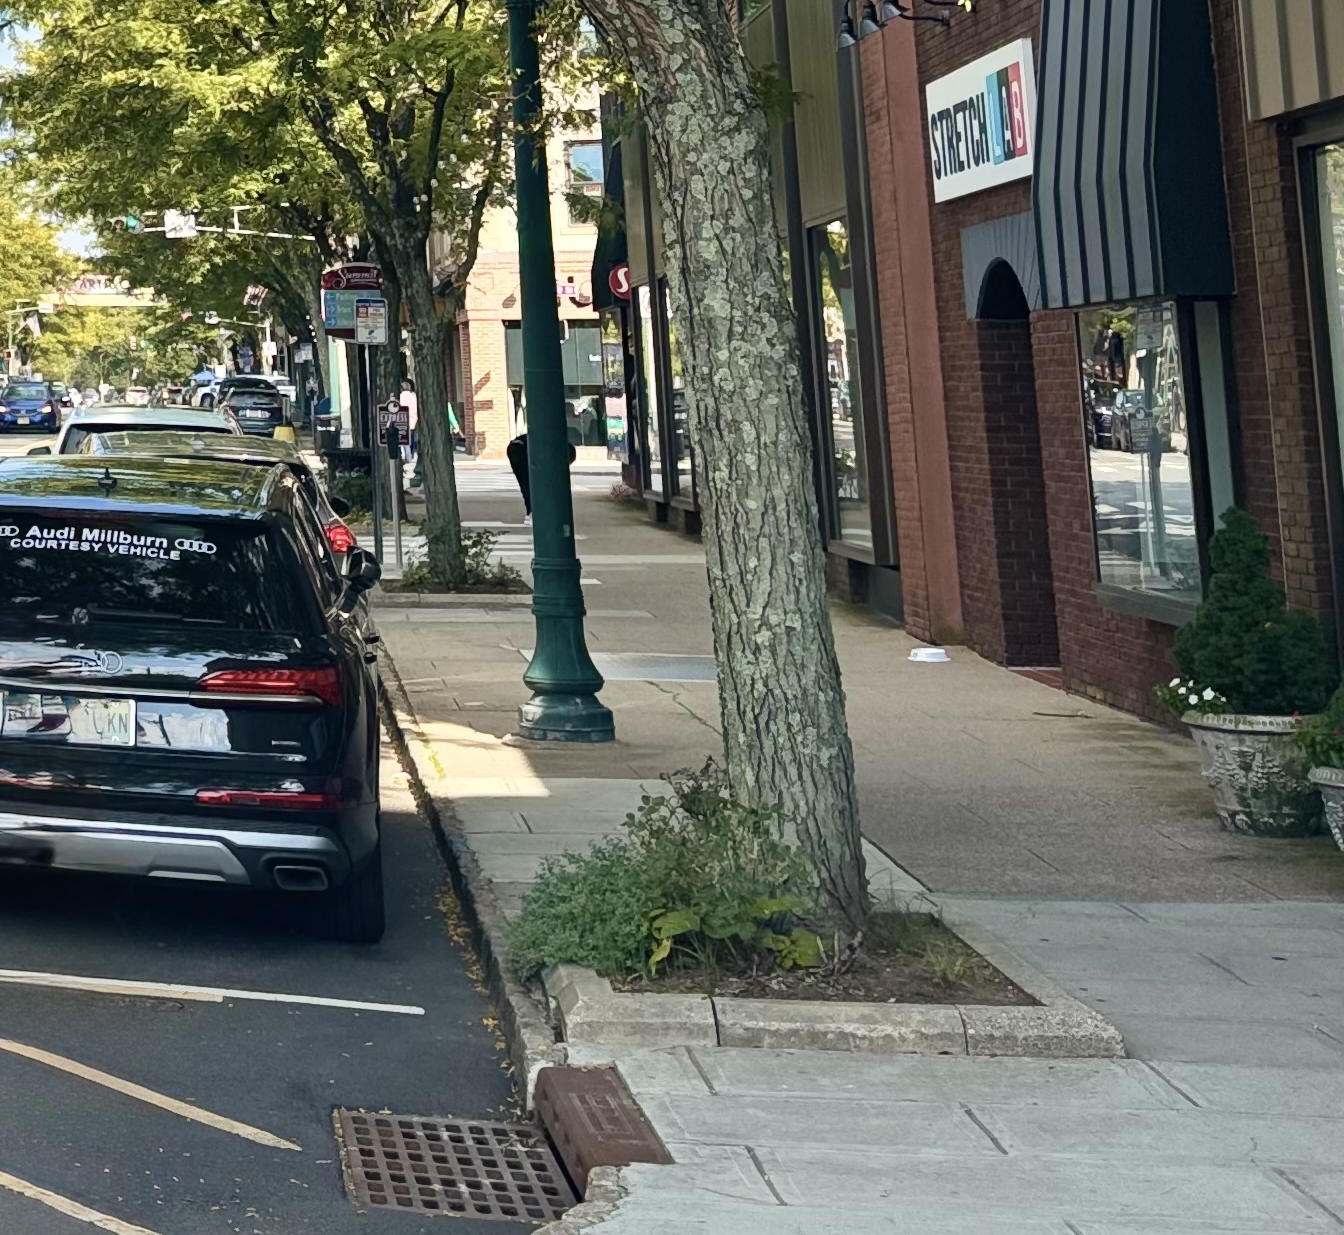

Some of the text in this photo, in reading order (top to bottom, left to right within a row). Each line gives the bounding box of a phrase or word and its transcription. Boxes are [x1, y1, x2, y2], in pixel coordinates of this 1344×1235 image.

[26, 525, 168, 548] Audi Millburn
[10, 538, 181, 560] COURTESY VEHICLE
